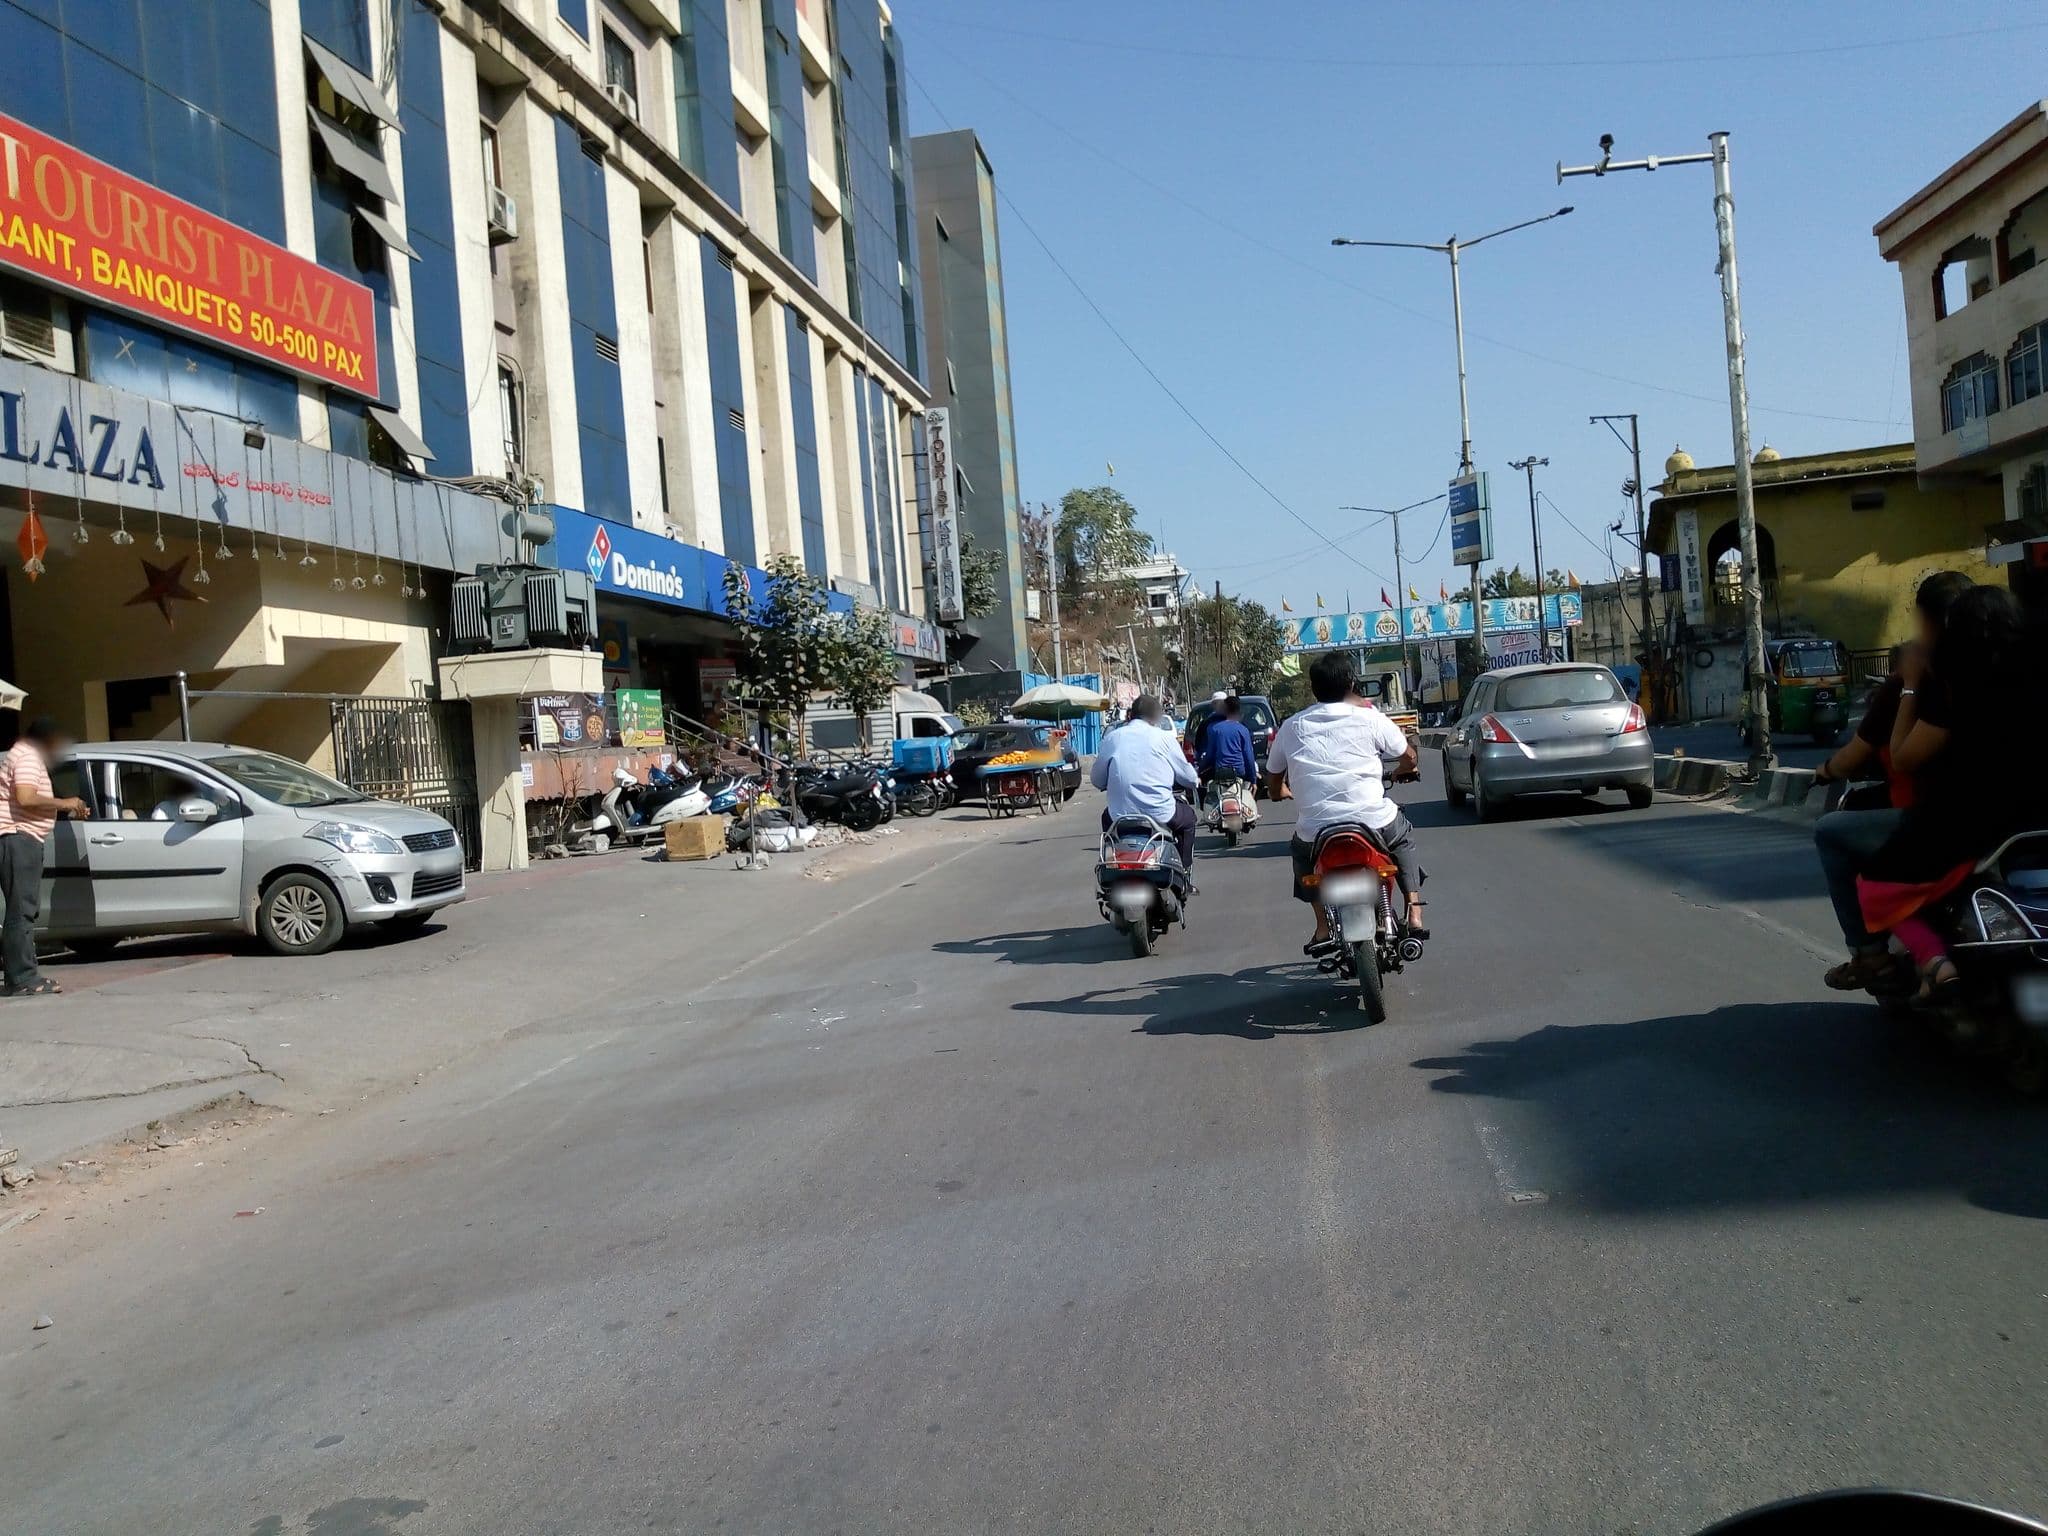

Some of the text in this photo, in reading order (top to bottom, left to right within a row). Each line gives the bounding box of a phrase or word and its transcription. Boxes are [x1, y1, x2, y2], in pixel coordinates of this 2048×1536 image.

[0, 132, 362, 345] TOURIST PLAZA
[91, 246, 243, 334] BANQUETS
[250, 311, 318, 363] 50-500
[324, 339, 364, 382] PAX
[930, 425, 948, 518] TOURIST
[612, 551, 684, 600] Domino's
